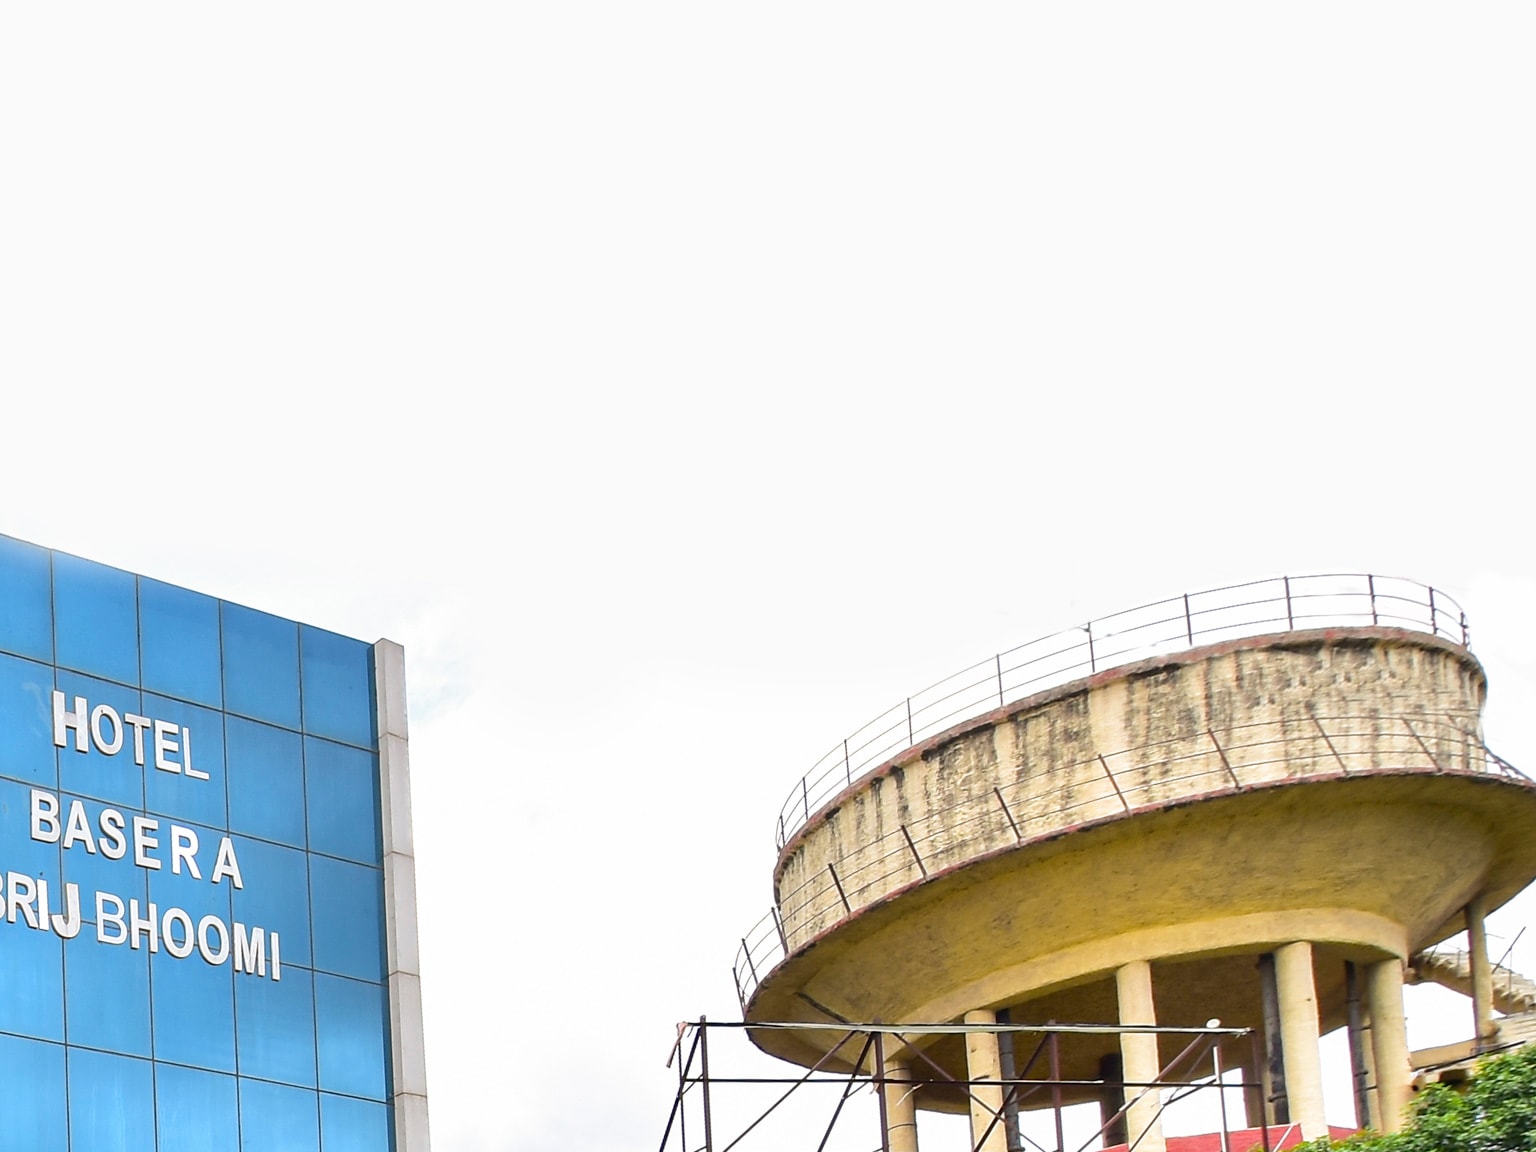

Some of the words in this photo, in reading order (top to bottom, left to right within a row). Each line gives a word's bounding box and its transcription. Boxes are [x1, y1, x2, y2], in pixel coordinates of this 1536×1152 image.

[52, 690, 210, 780] HOTEL
[30, 789, 244, 890] BASERA
[95, 891, 281, 981] BHOOMI
